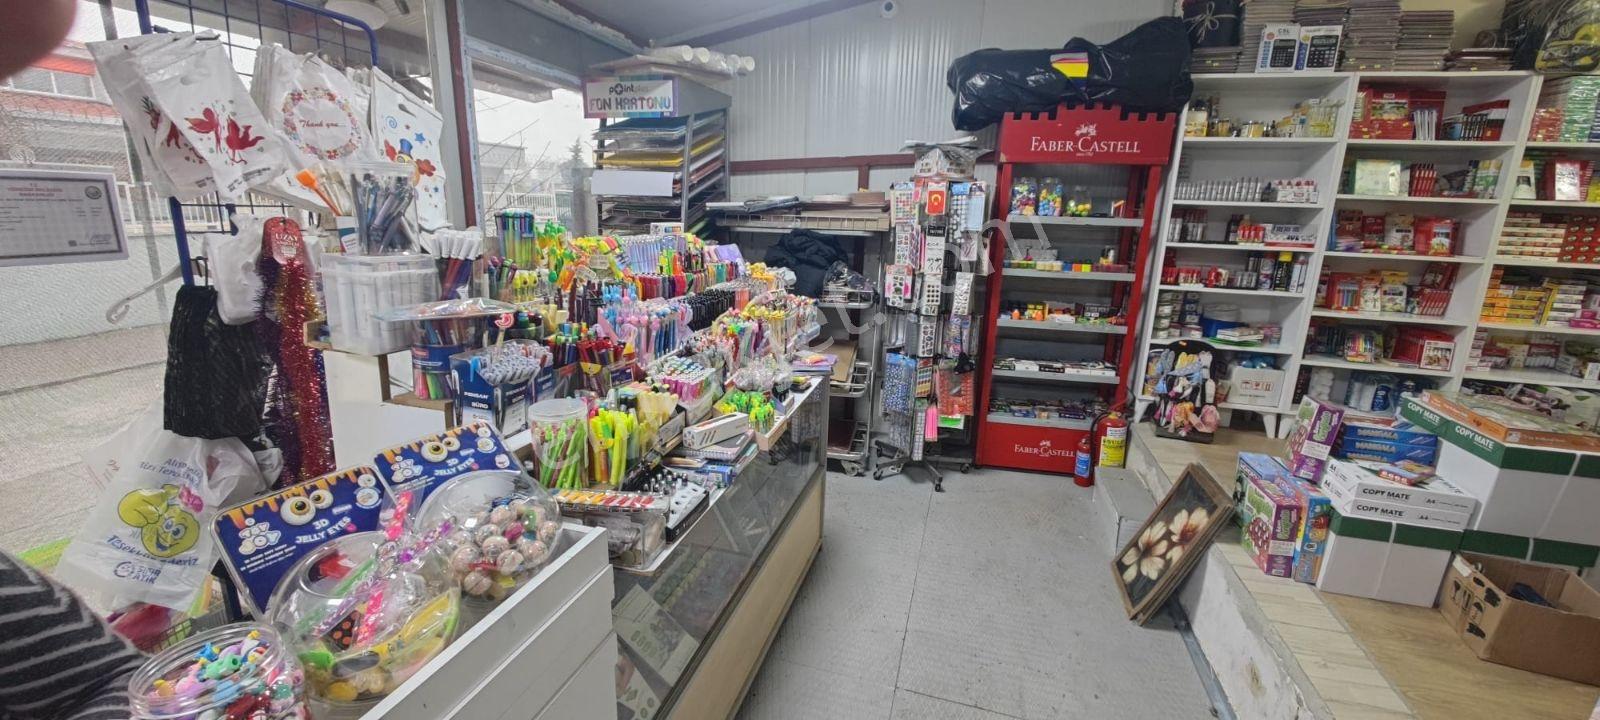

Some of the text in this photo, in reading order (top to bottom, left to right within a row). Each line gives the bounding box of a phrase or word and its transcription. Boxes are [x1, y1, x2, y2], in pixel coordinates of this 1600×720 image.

[300, 120, 323, 128] Thank
[1030, 136, 1141, 153] FABER-CASTELL
[1407, 401, 1424, 415] COPY
[1423, 409, 1441, 423] MATE
[1454, 425, 1475, 440] COPY
[1474, 435, 1496, 450] MATE
[1014, 443, 1076, 457] FABER-CASTELL
[1363, 488, 1386, 496] COPY
[1387, 490, 1411, 501] MATE
[1357, 504, 1380, 513] COPY
[1381, 508, 1404, 517] MATE
[295, 516, 351, 544] JELLY EYES
[313, 519, 330, 530] 3D
